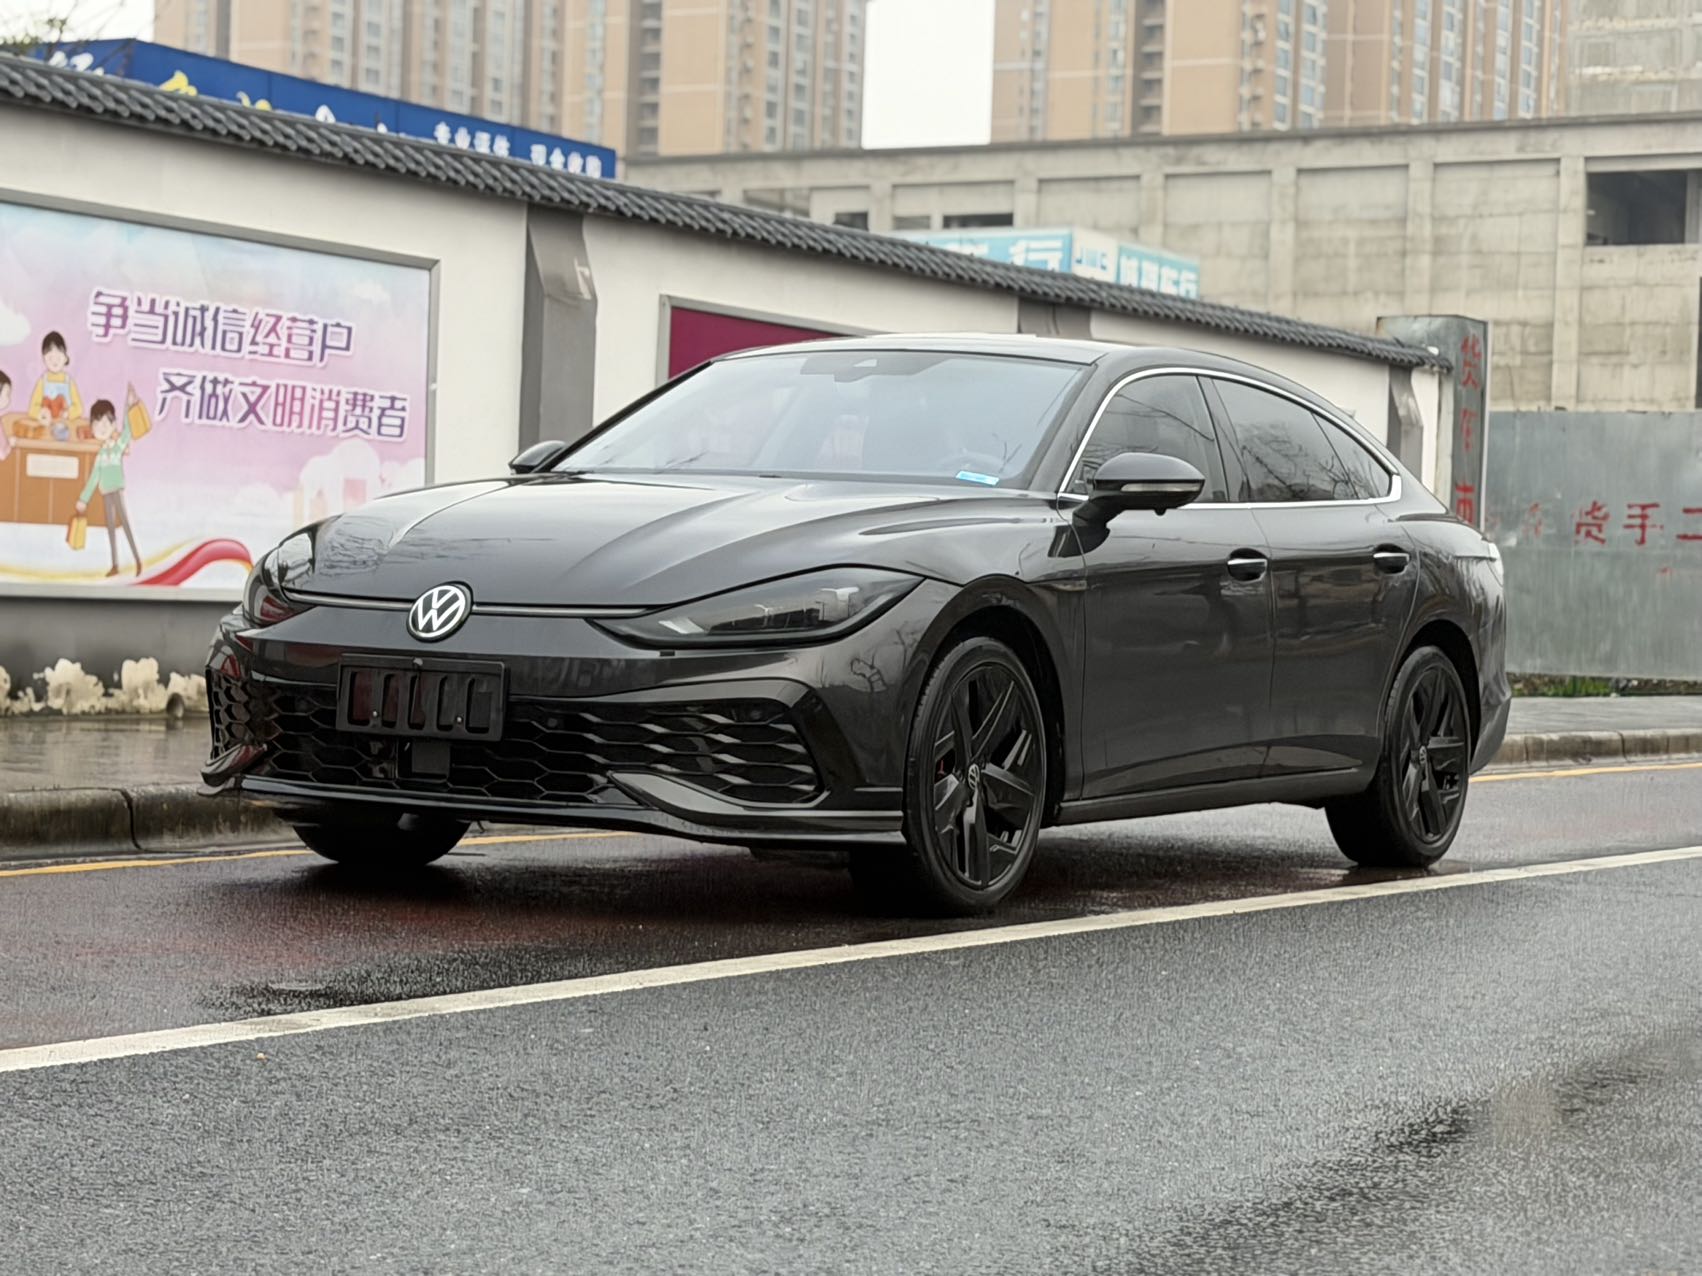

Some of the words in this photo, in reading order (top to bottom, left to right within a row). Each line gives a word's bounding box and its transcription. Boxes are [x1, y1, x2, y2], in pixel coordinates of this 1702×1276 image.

[90, 289, 354, 364] 争当诚信经营户
[157, 371, 409, 439] 齐做文明消费者
